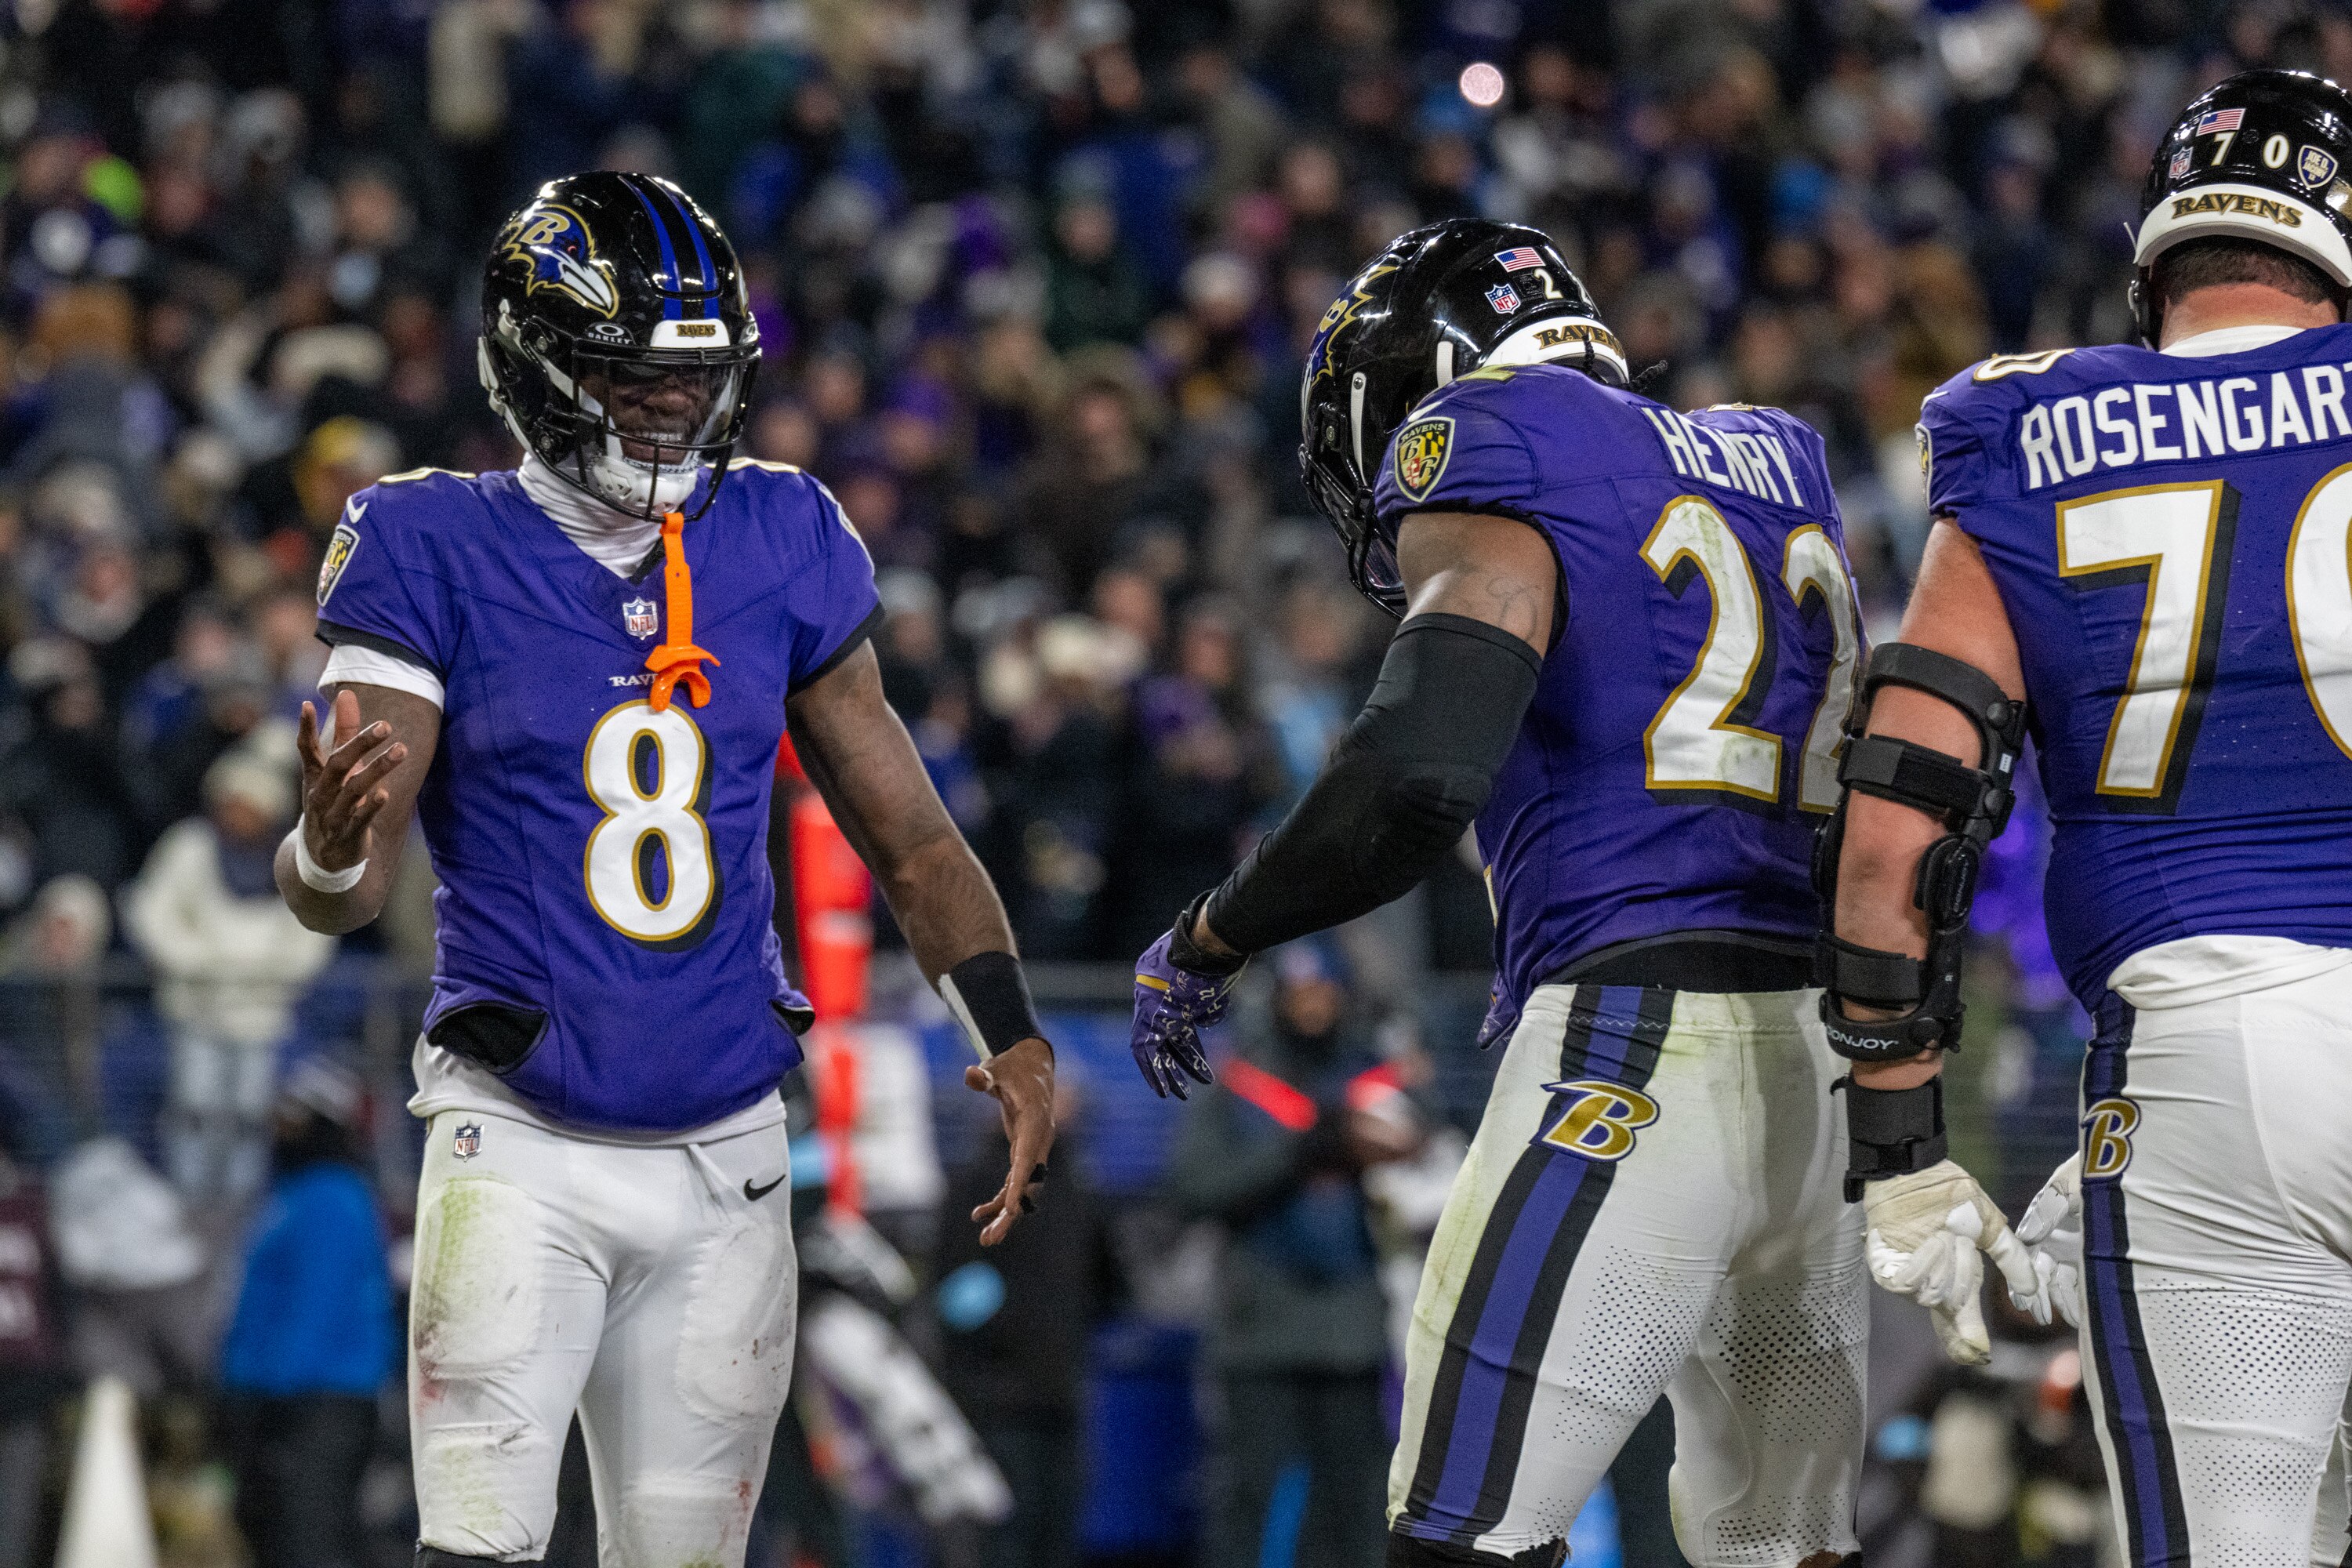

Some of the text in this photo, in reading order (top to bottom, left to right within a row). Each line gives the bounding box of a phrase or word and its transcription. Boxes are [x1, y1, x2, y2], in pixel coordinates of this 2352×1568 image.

[2172, 159, 2188, 174] NFL
[2172, 193, 2303, 228] RAVENS
[521, 211, 570, 245] B
[1494, 295, 1517, 310] NFL
[588, 332, 631, 345] OAKLEY
[676, 324, 716, 337] RAVENS
[1400, 423, 1446, 444] RAVENS
[2020, 361, 2352, 489] ROSENGAR
[1642, 408, 1803, 507] HENRY
[630, 615, 653, 632] NFL
[583, 699, 720, 947] 8
[1537, 1080, 1658, 1160] B
[456, 1138, 477, 1153] NFL
[2082, 1098, 2140, 1178] B
